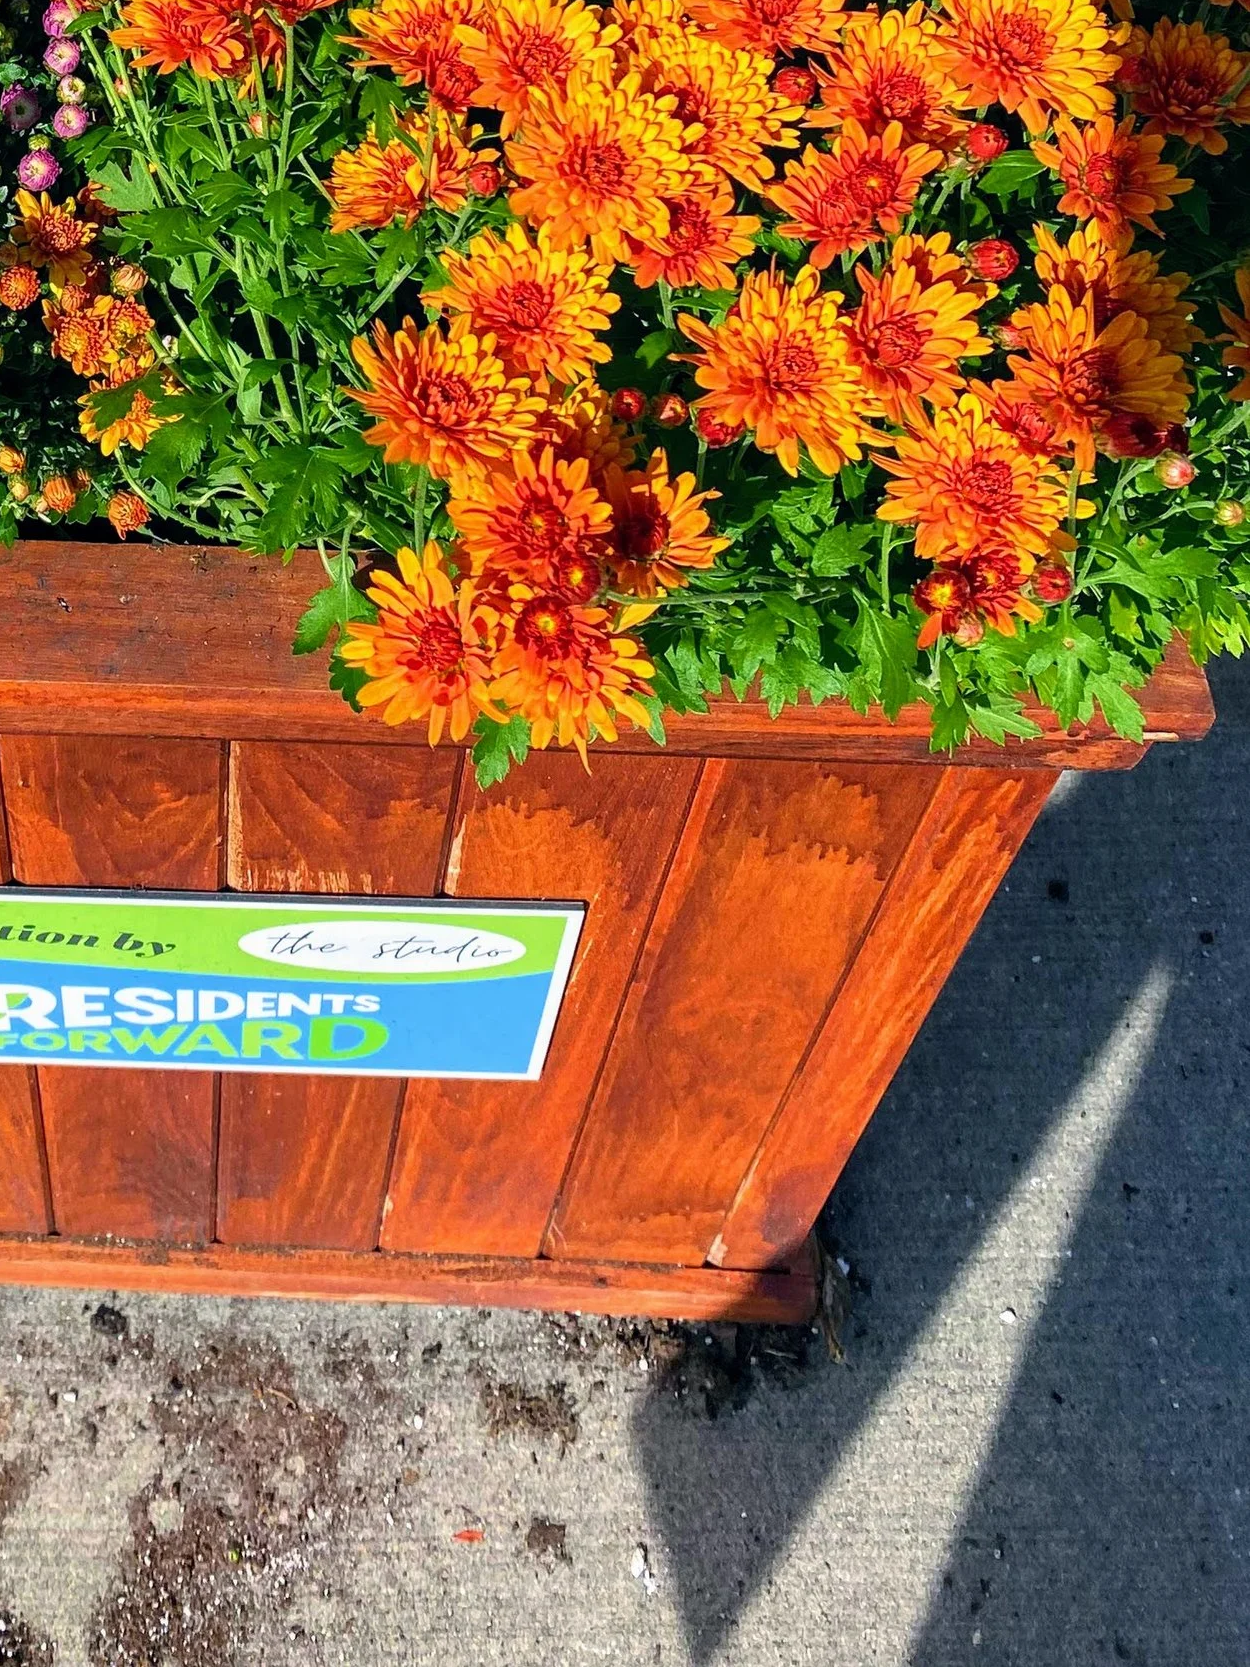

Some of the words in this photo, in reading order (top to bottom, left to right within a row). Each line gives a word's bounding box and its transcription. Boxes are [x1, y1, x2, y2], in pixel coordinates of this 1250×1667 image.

[112, 931, 177, 958] by
[266, 930, 347, 955] the
[372, 935, 513, 963] studio
